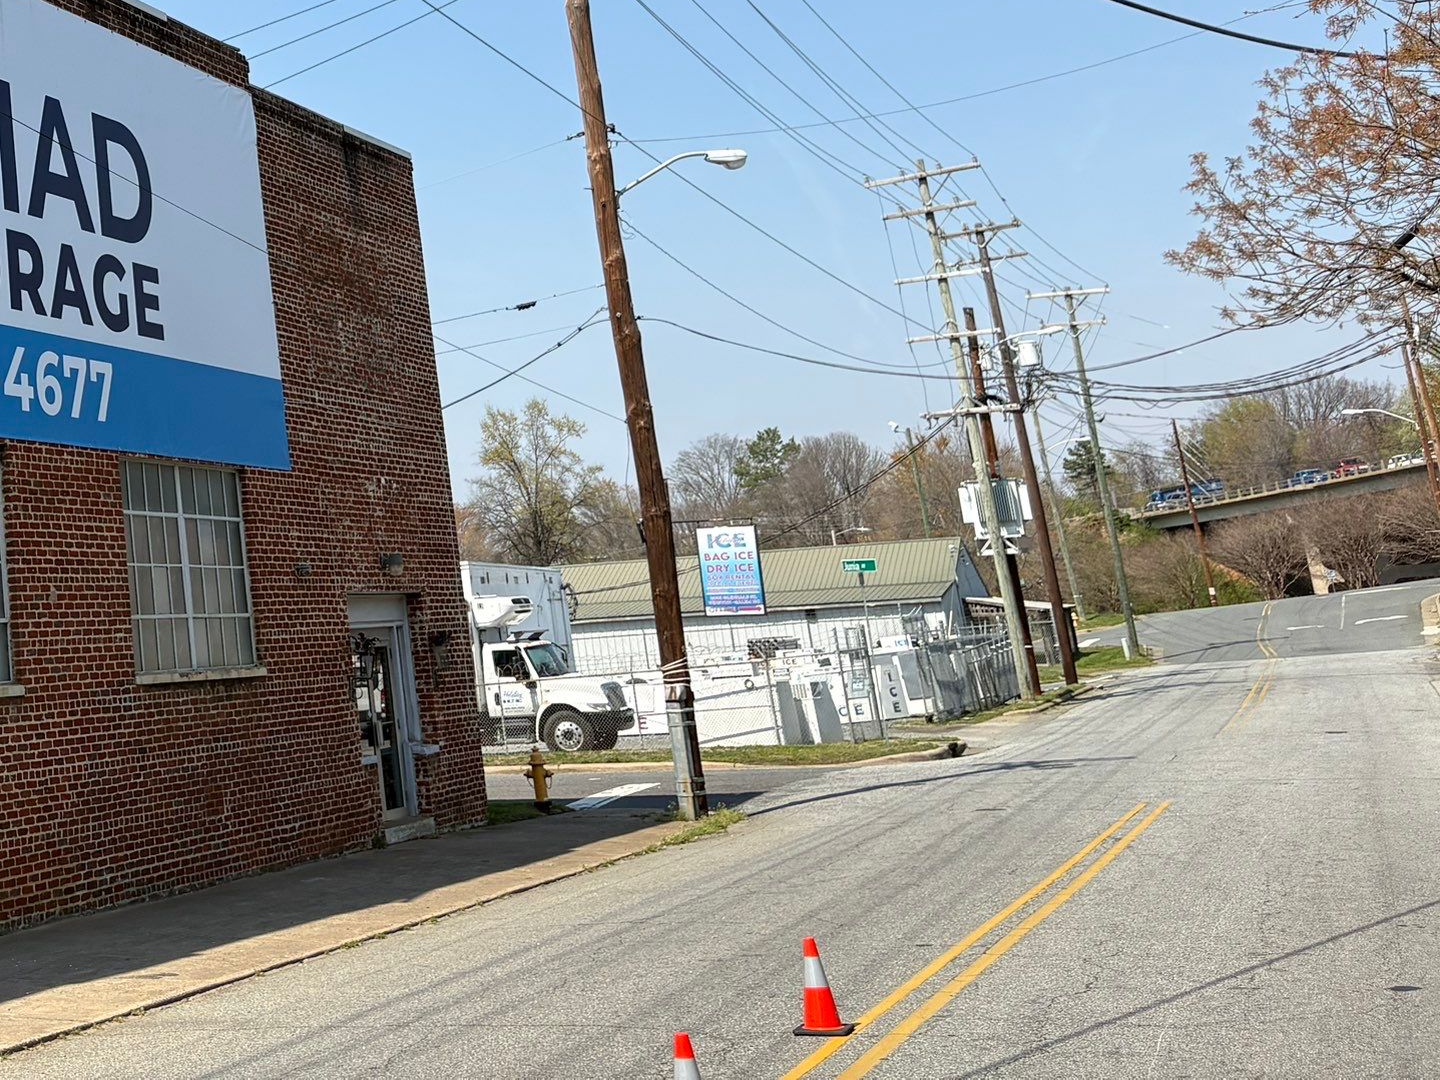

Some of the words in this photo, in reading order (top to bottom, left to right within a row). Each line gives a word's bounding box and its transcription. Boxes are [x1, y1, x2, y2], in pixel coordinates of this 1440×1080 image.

[707, 533, 746, 548] ICE
[704, 552, 730, 561] BAG
[734, 551, 754, 560] ICE
[706, 564, 729, 573] DRY
[735, 563, 754, 572] ICE
